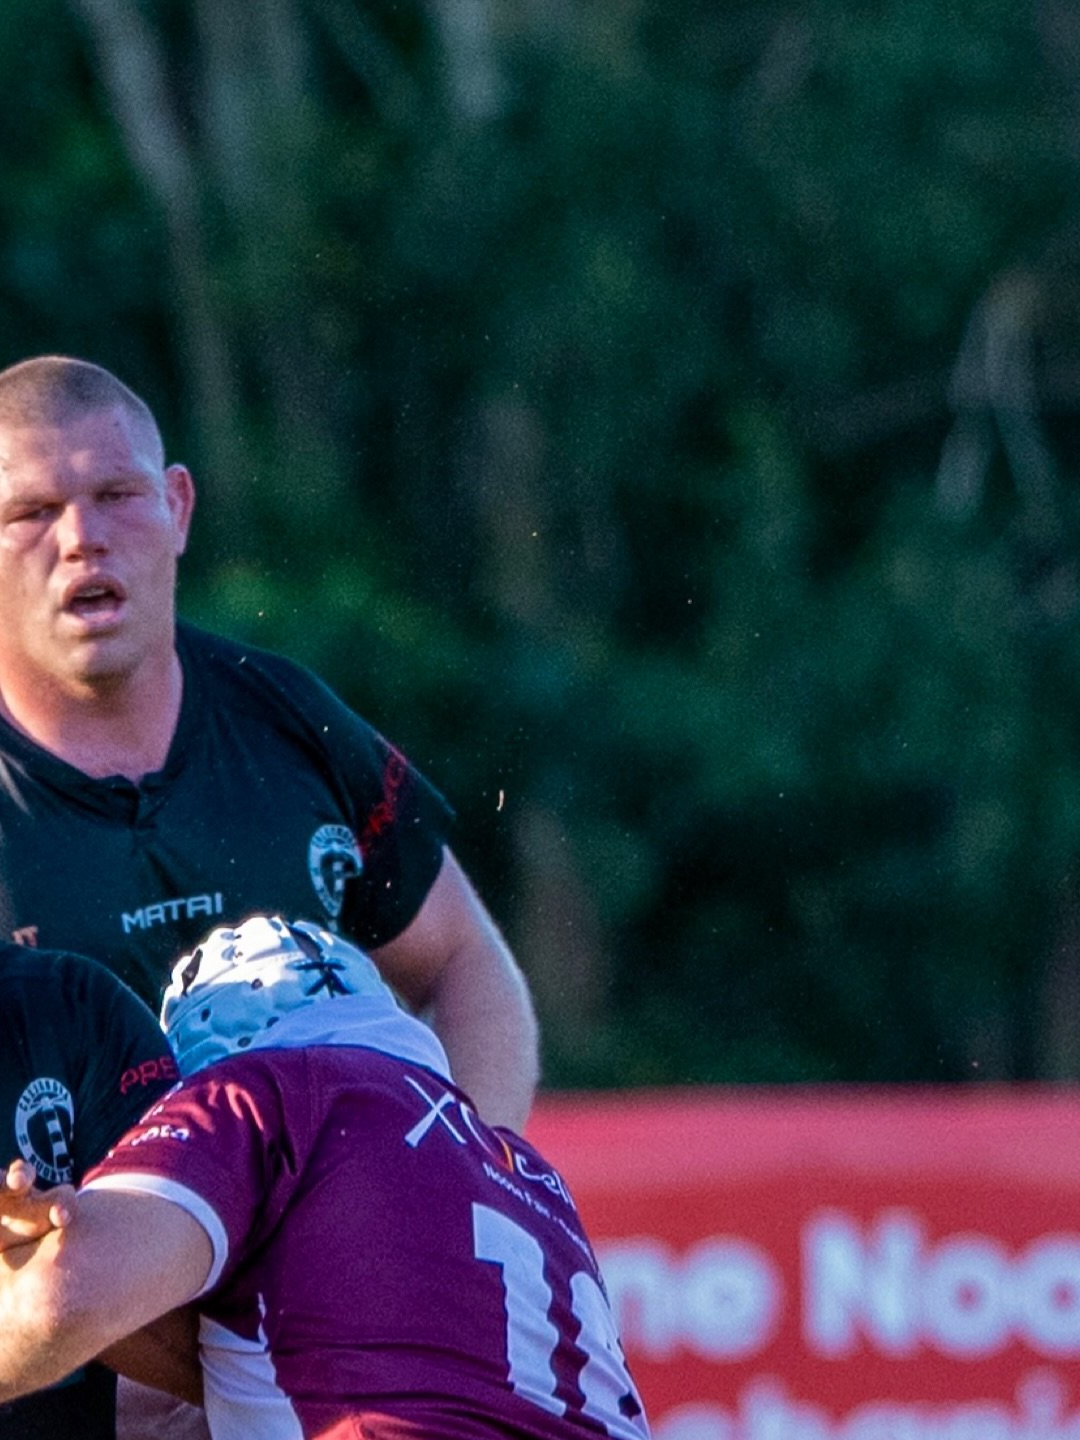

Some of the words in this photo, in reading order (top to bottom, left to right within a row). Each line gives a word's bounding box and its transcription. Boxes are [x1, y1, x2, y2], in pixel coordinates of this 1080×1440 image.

[120, 892, 223, 934] MATAI
[120, 1055, 178, 1095] PRE
[800, 1205, 1080, 1362] Noo
